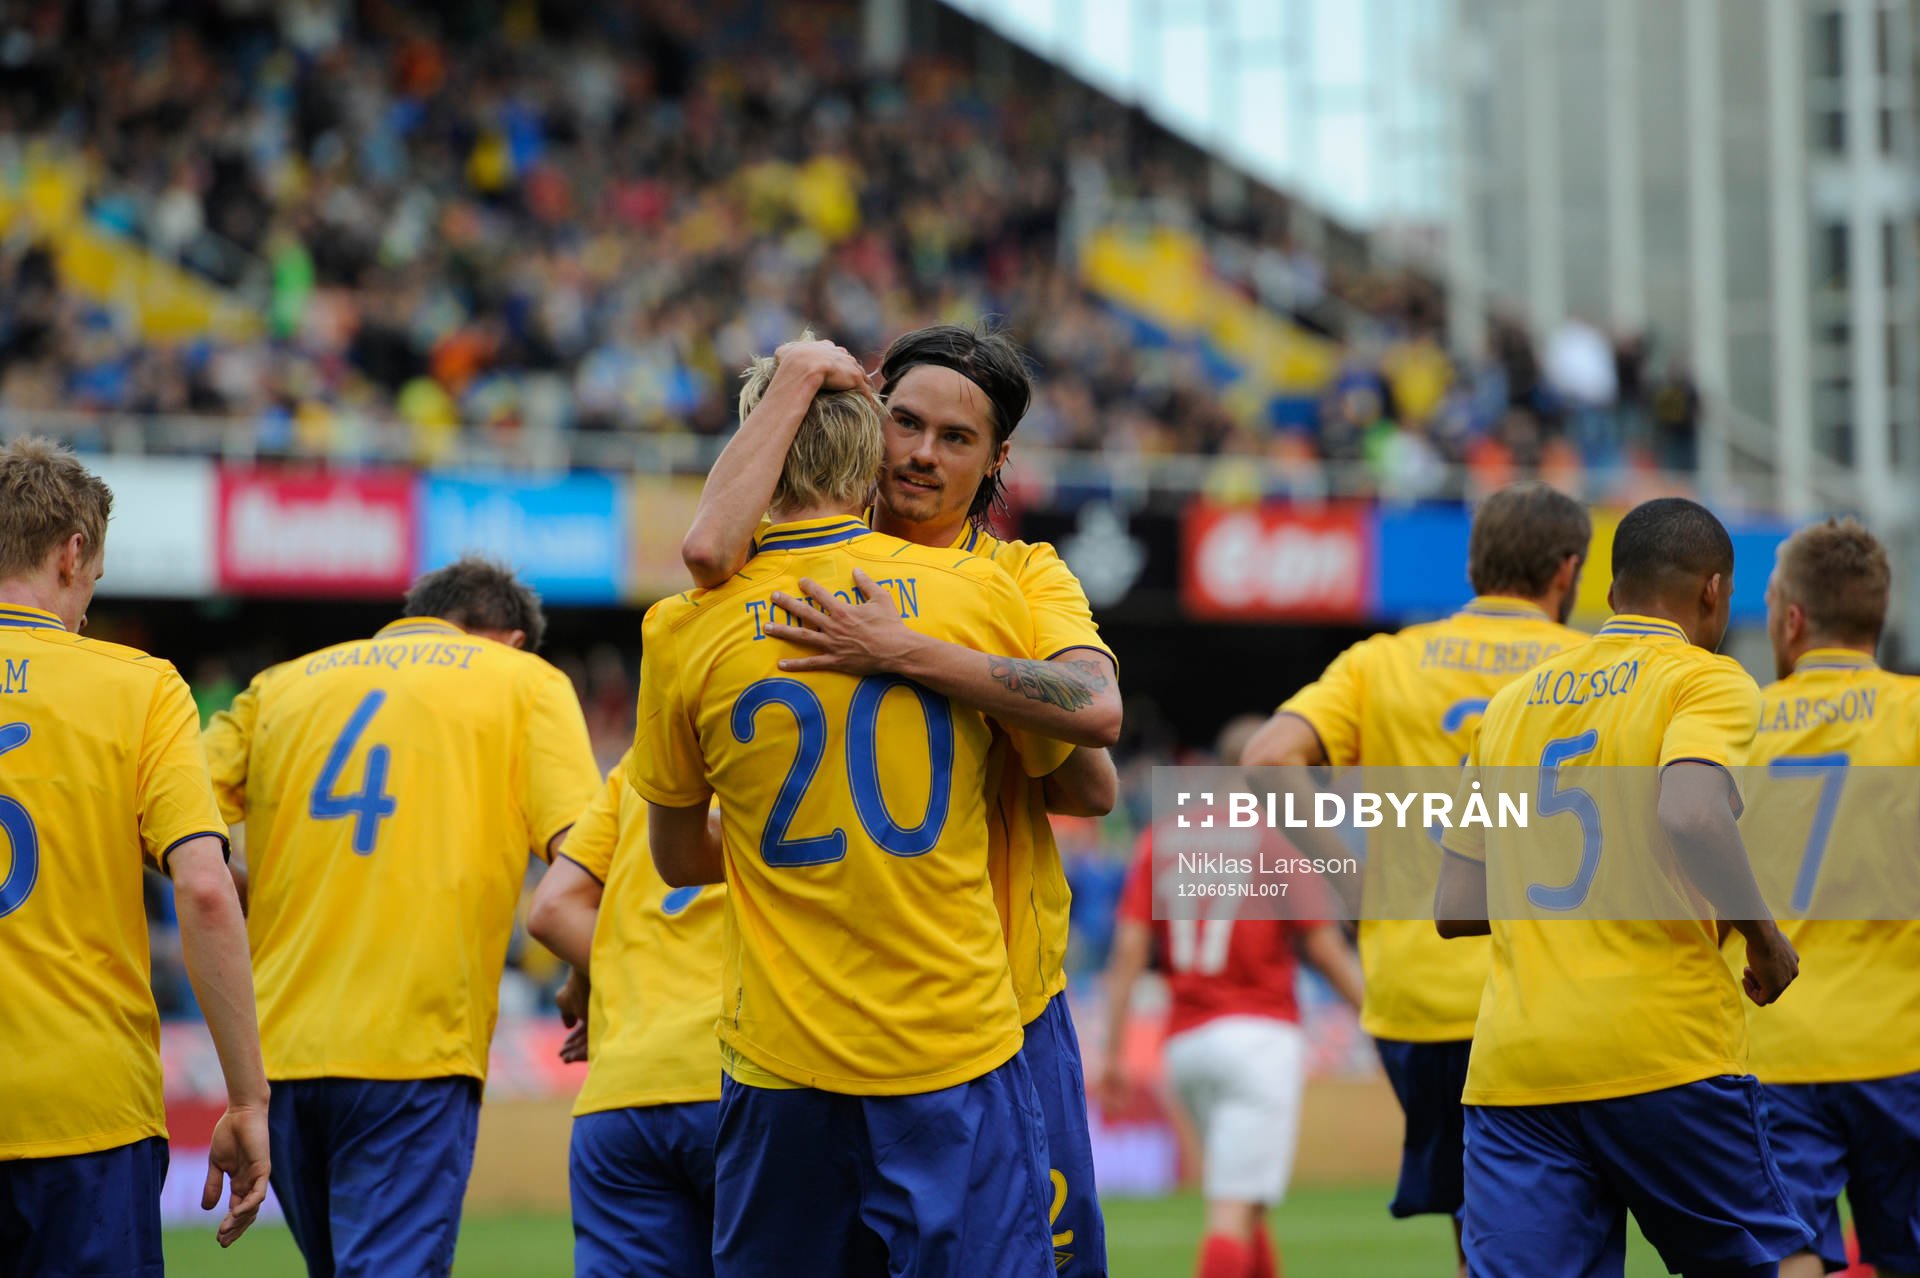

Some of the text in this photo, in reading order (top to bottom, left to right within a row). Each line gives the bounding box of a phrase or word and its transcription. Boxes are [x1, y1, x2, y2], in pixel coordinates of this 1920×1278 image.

[0, 659, 30, 694] M
[305, 643, 478, 676] GRANQVIST
[310, 689, 396, 855] 4
[731, 675, 955, 868] 20
[1527, 728, 1603, 912] 5
[1768, 751, 1851, 913] 7
